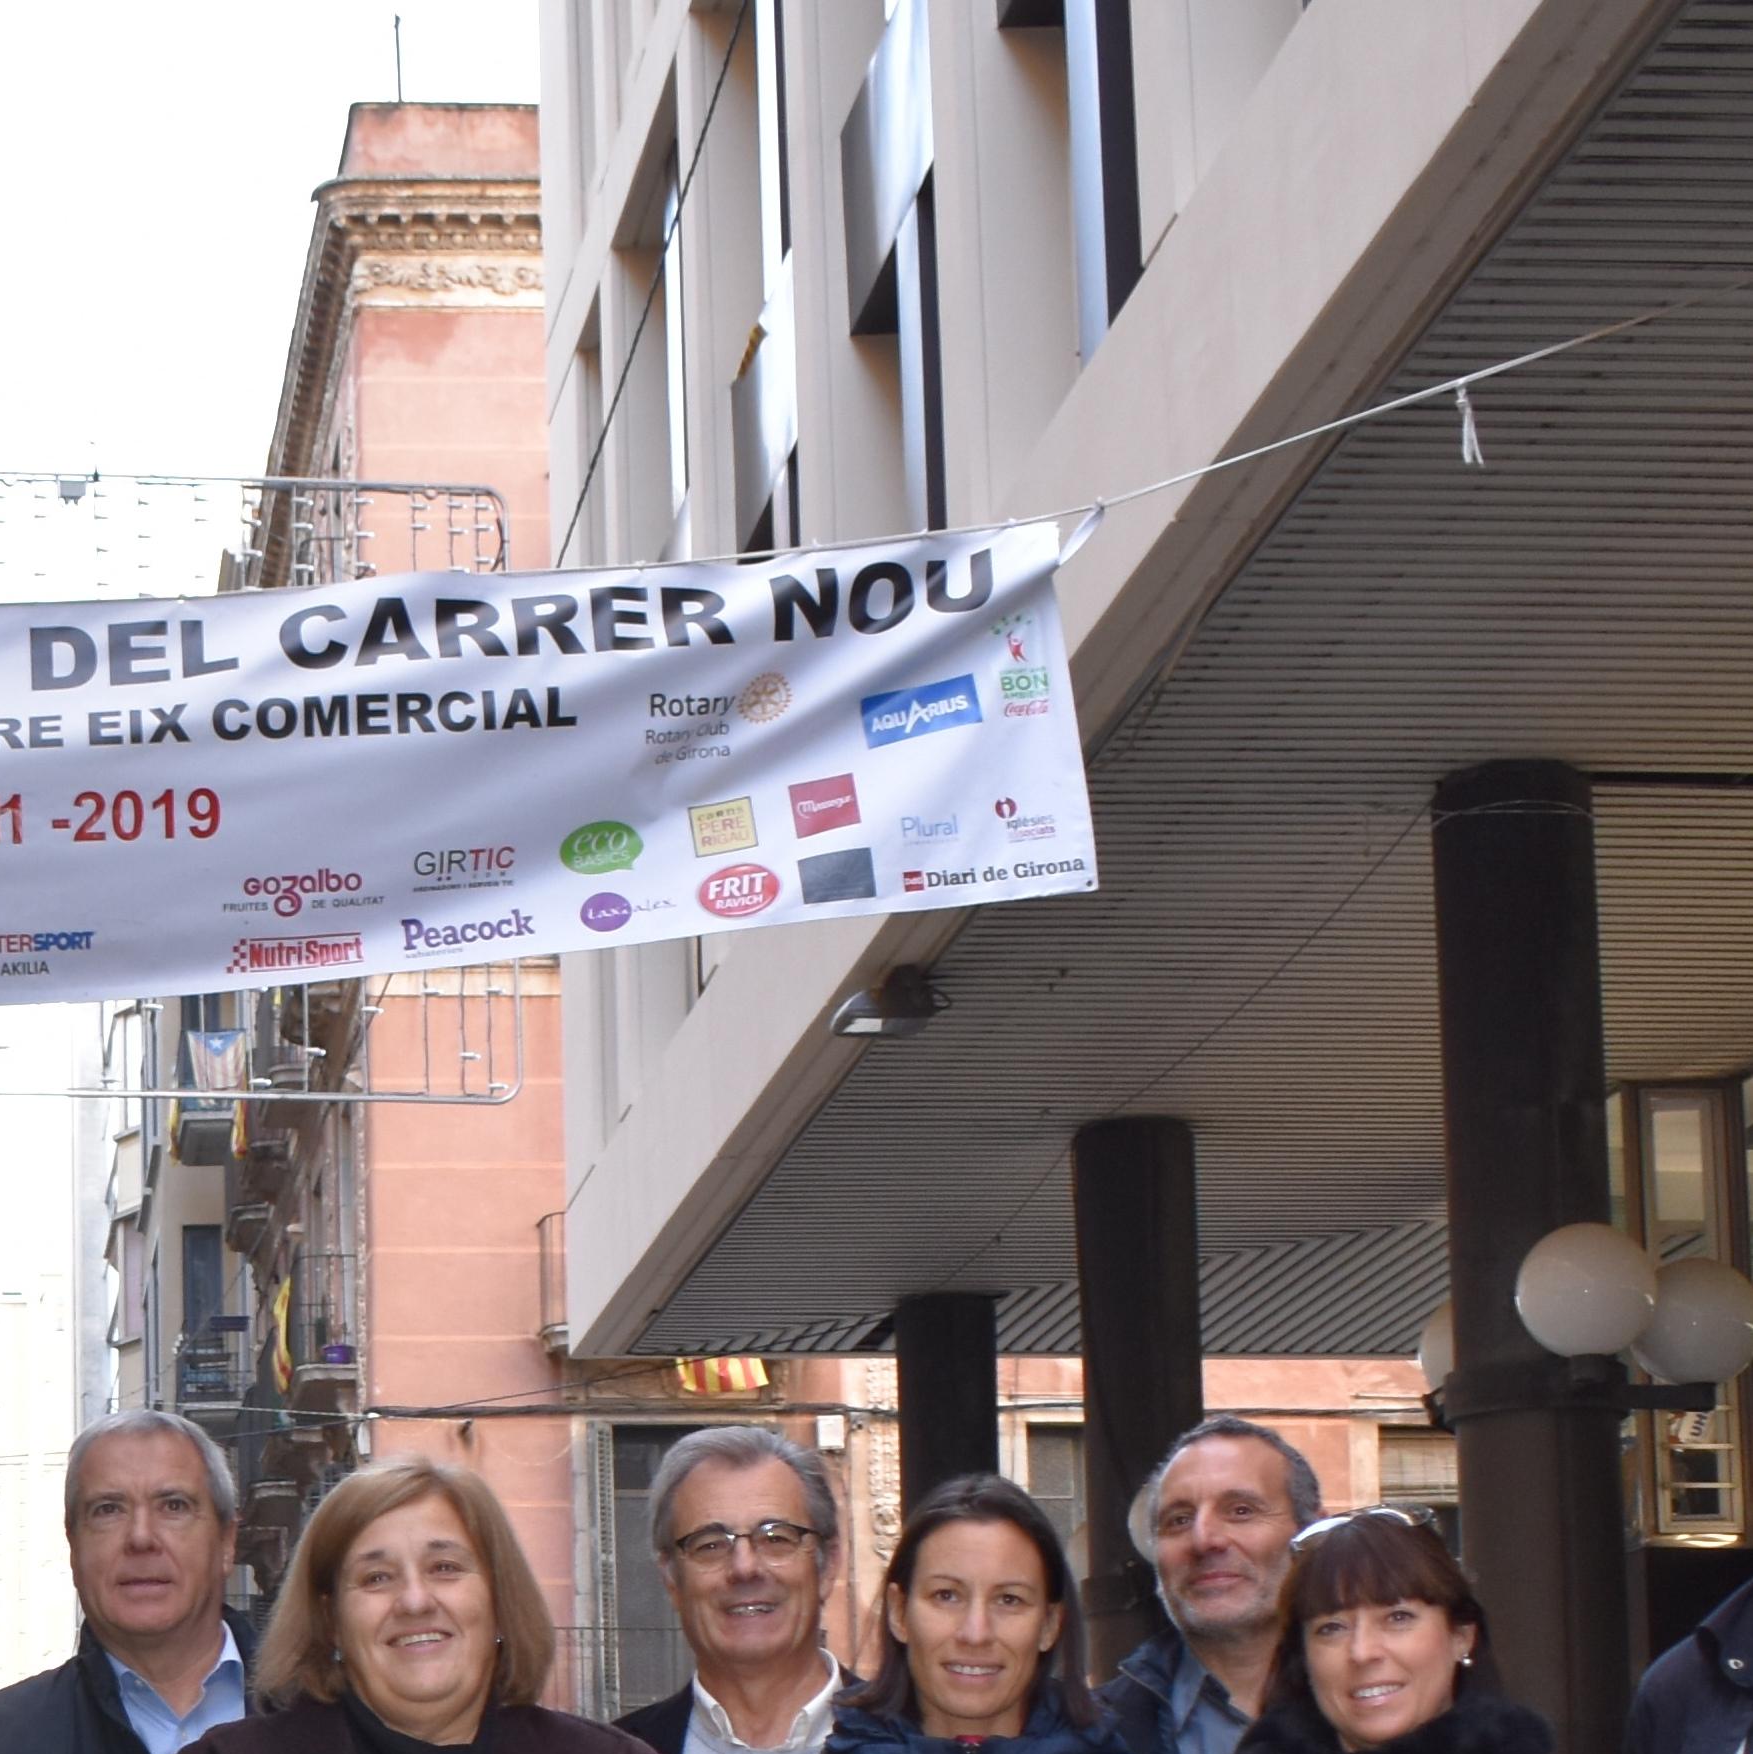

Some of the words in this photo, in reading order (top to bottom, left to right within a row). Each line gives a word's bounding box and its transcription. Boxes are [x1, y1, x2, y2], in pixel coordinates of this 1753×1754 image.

[29, 619, 239, 692] DEL
[279, 585, 735, 670] CARRER
[769, 548, 993, 643] NOU
[88, 703, 191, 746] EIX
[212, 686, 578, 741] COMERCIAL
[649, 692, 736, 718] Rotary
[871, 694, 968, 734] AQUARIUS
[676, 742, 730, 761] Girona
[901, 813, 958, 838] Plural
[574, 830, 628, 853] eco
[414, 846, 515, 880] GIRTIC
[573, 851, 631, 869] BASICS
[926, 866, 976, 888] Diari
[983, 866, 1008, 882] de
[1013, 856, 1085, 880] Girona
[708, 872, 769, 900] FRIT
[223, 902, 268, 913] FRUITES
[312, 900, 326, 909] DE
[332, 896, 385, 908] QUALITAT
[715, 894, 764, 910] RAVICH
[401, 908, 536, 951] Peacock
[249, 937, 363, 968] NutriSport
[0, 961, 50, 976] AKILIA
